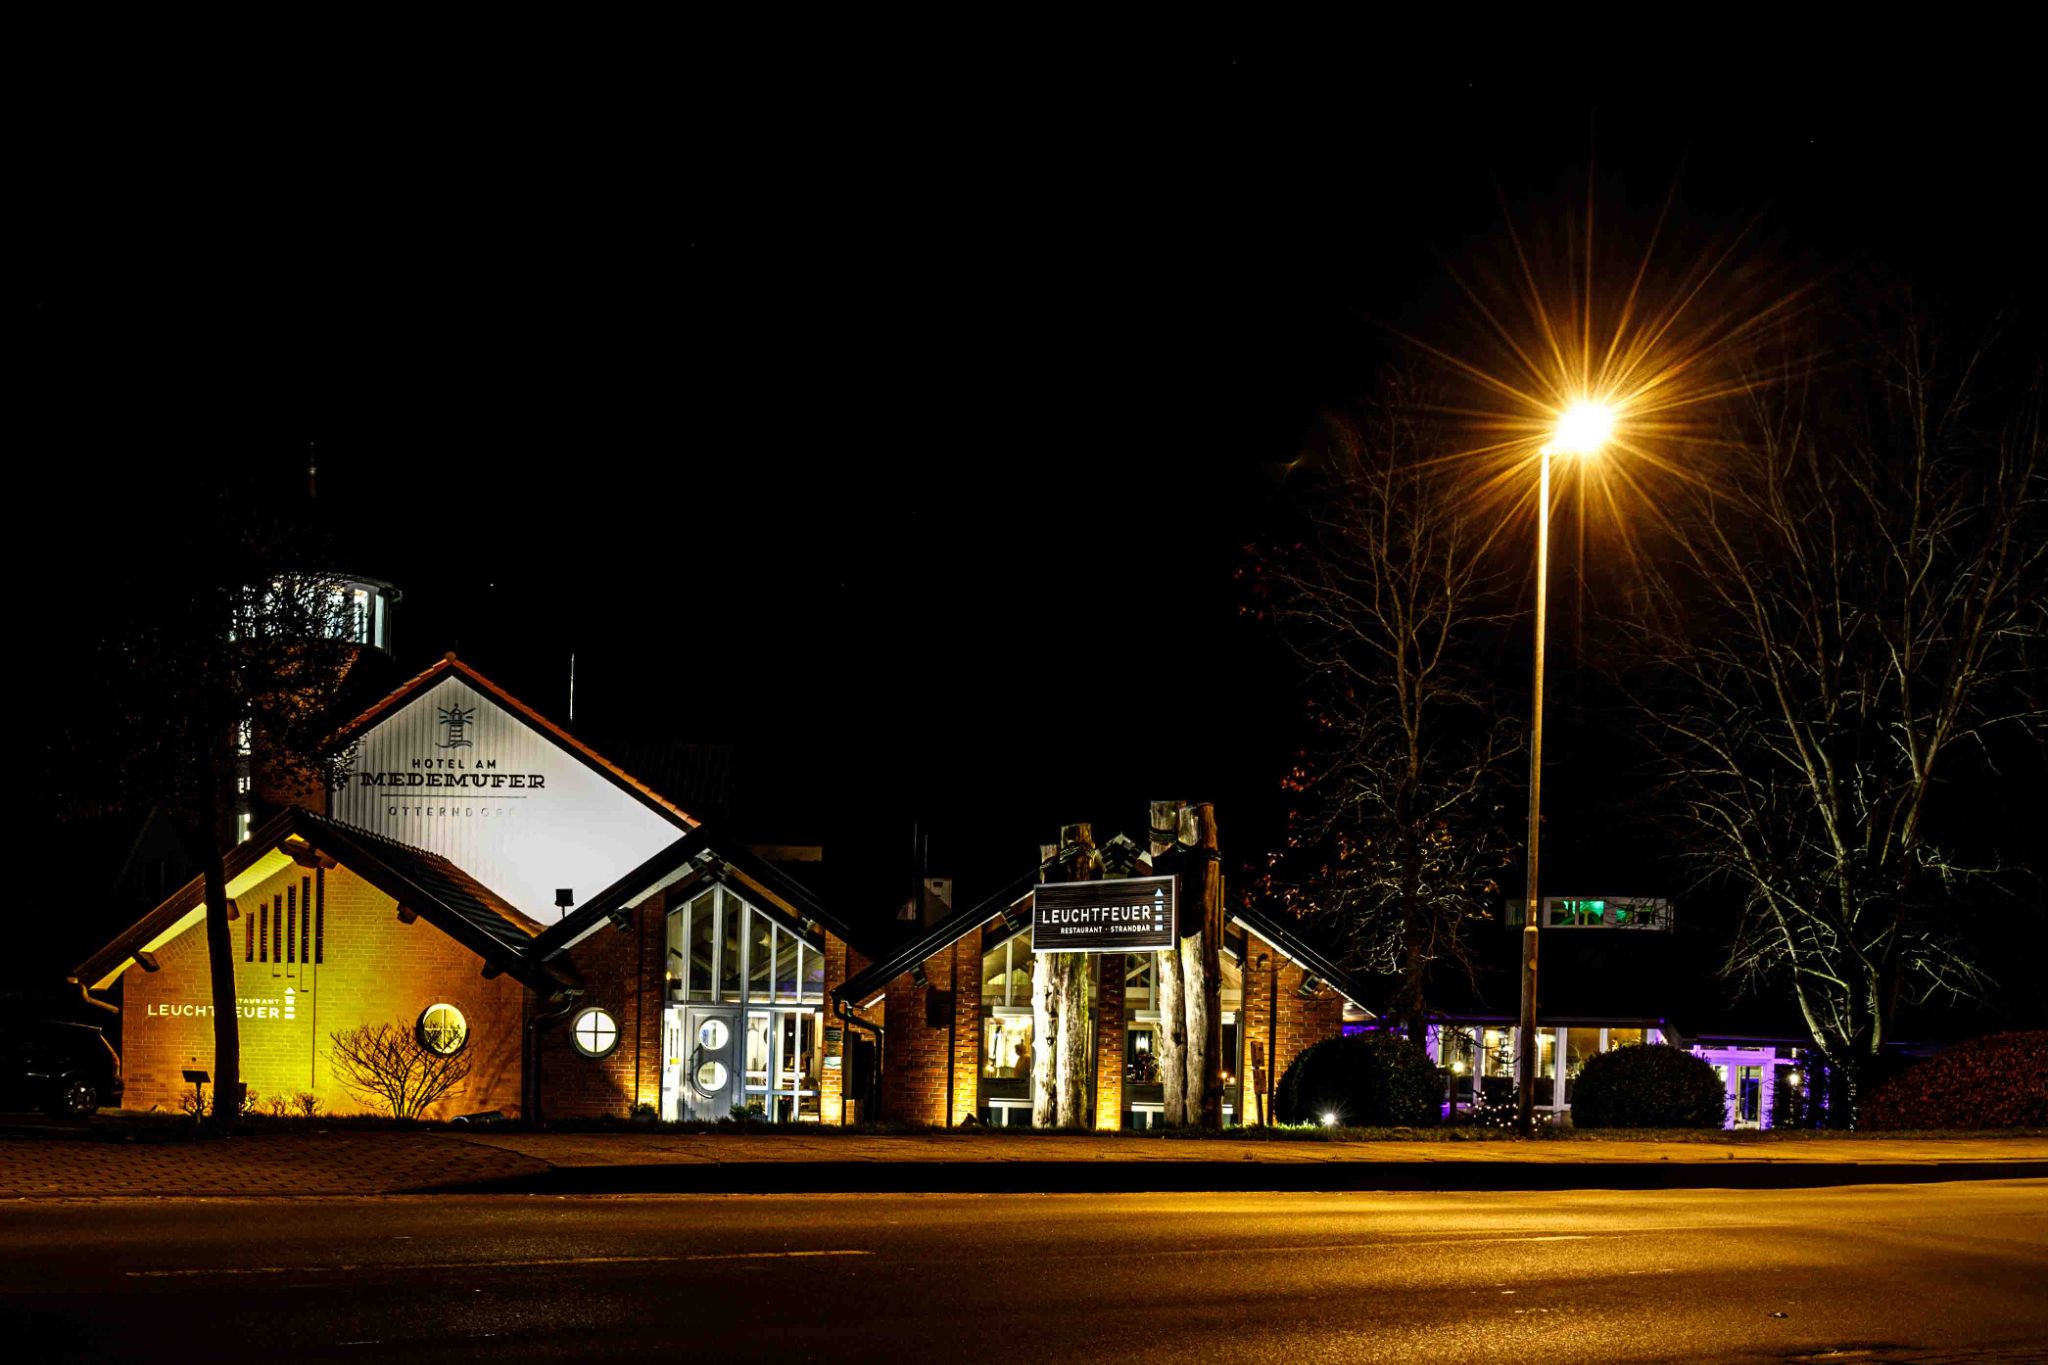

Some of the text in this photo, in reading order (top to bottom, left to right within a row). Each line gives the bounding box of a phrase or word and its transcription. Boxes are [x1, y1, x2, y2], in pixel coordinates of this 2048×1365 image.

[412, 758, 497, 769] HOTEL AM
[360, 772, 545, 789] MEDEMUFER
[1042, 905, 1150, 923] LEUCHTFEUER
[1060, 924, 1150, 934] RESTAURANT STRANDBAR
[148, 1004, 279, 1018] LEUCHTEUER
